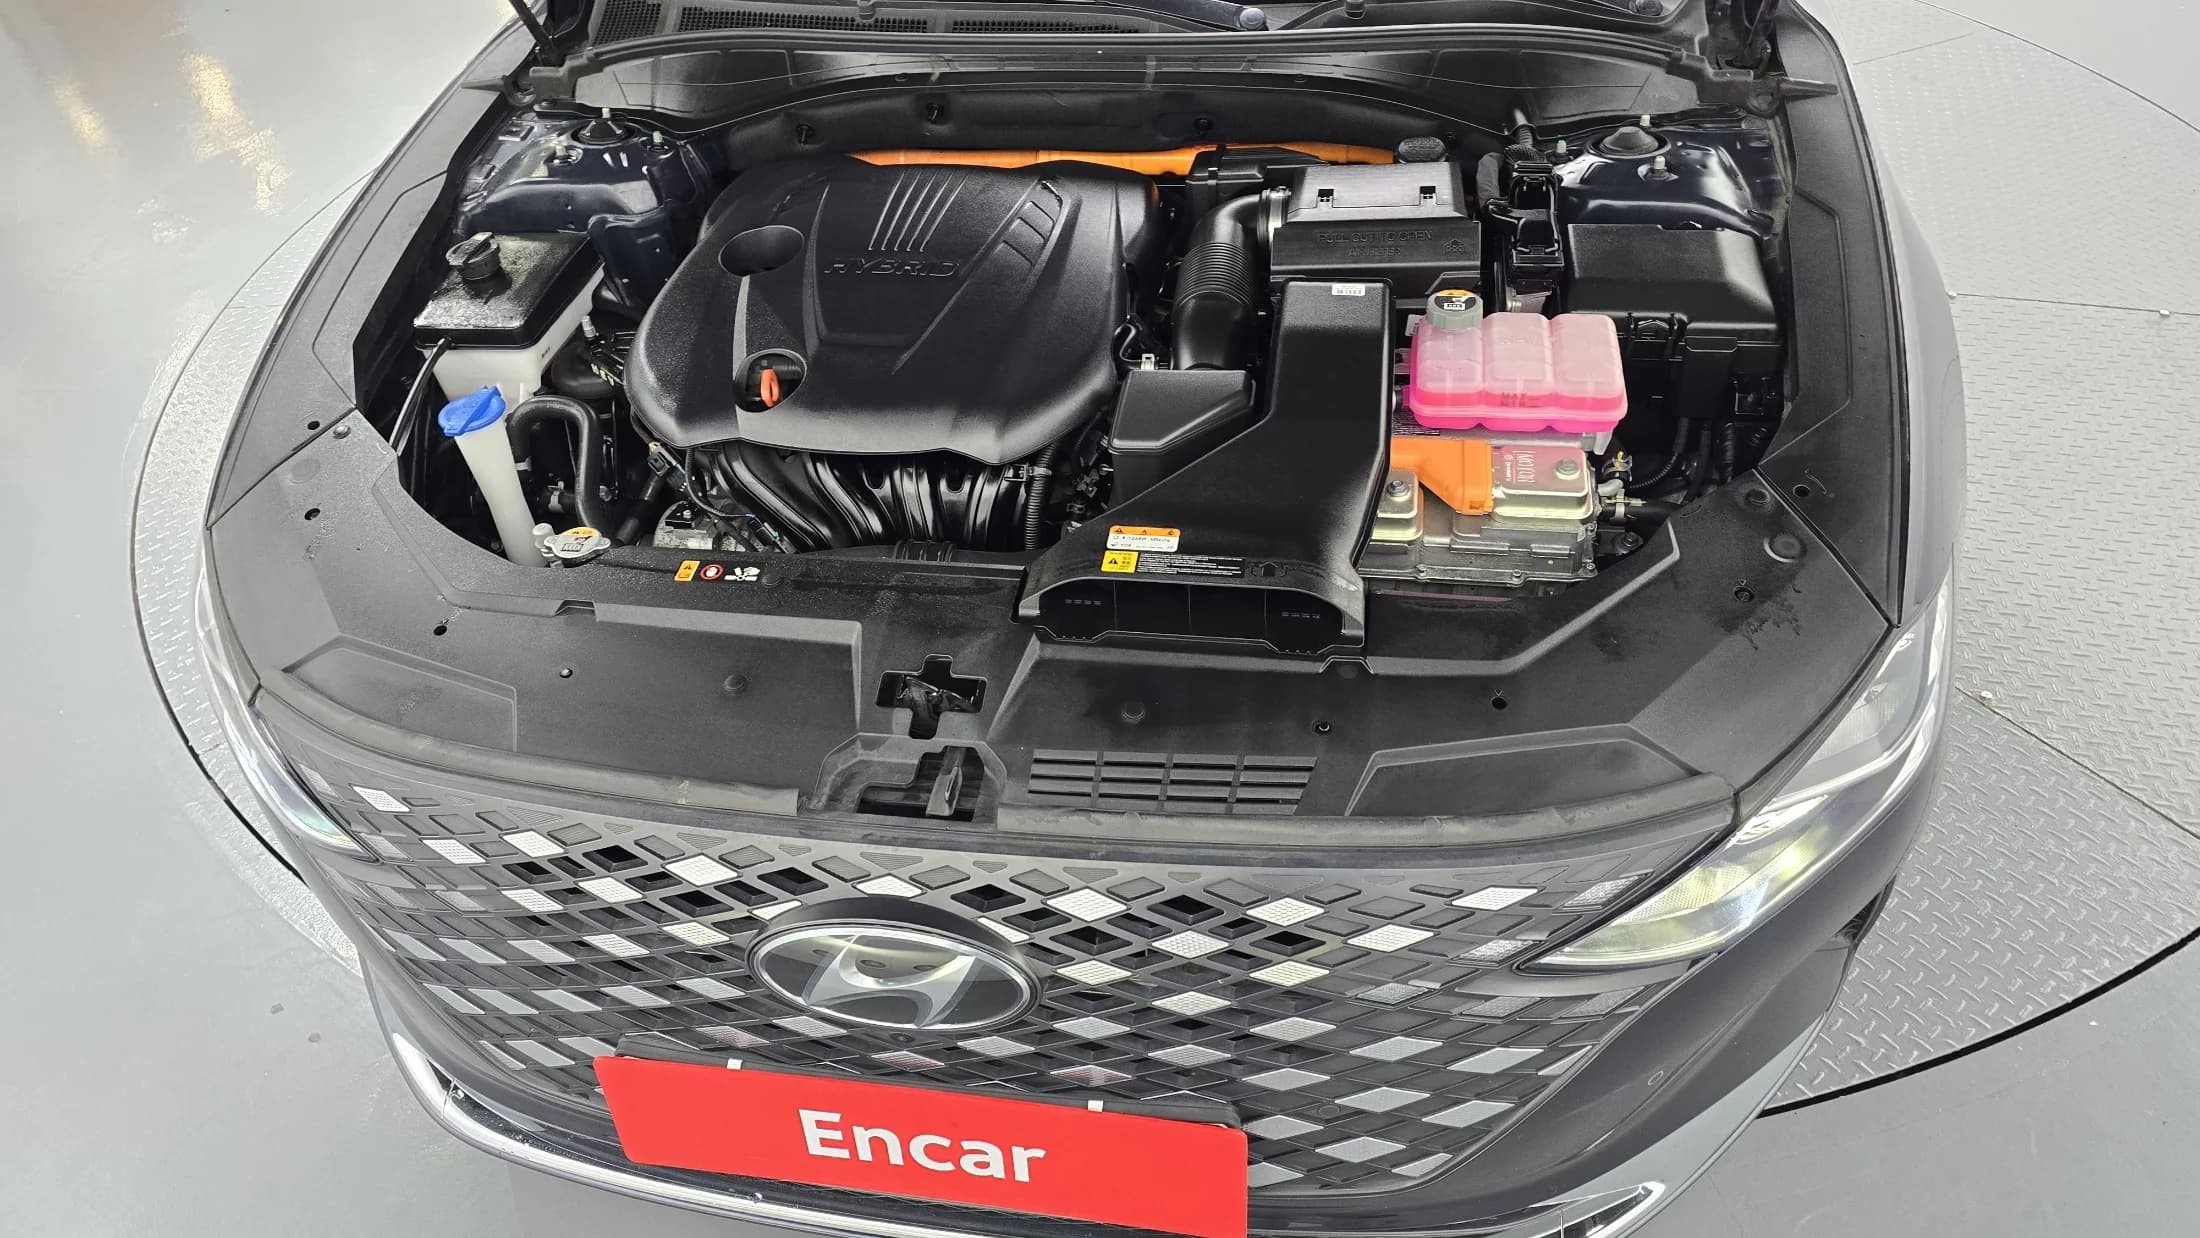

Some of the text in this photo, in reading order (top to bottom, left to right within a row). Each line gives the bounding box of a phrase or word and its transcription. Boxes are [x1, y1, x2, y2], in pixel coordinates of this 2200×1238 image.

[1379, 230, 1396, 241] TO
[1399, 230, 1433, 241] OPEN
[823, 257, 960, 277] HYBRID
[798, 1108, 1047, 1183] Encar
